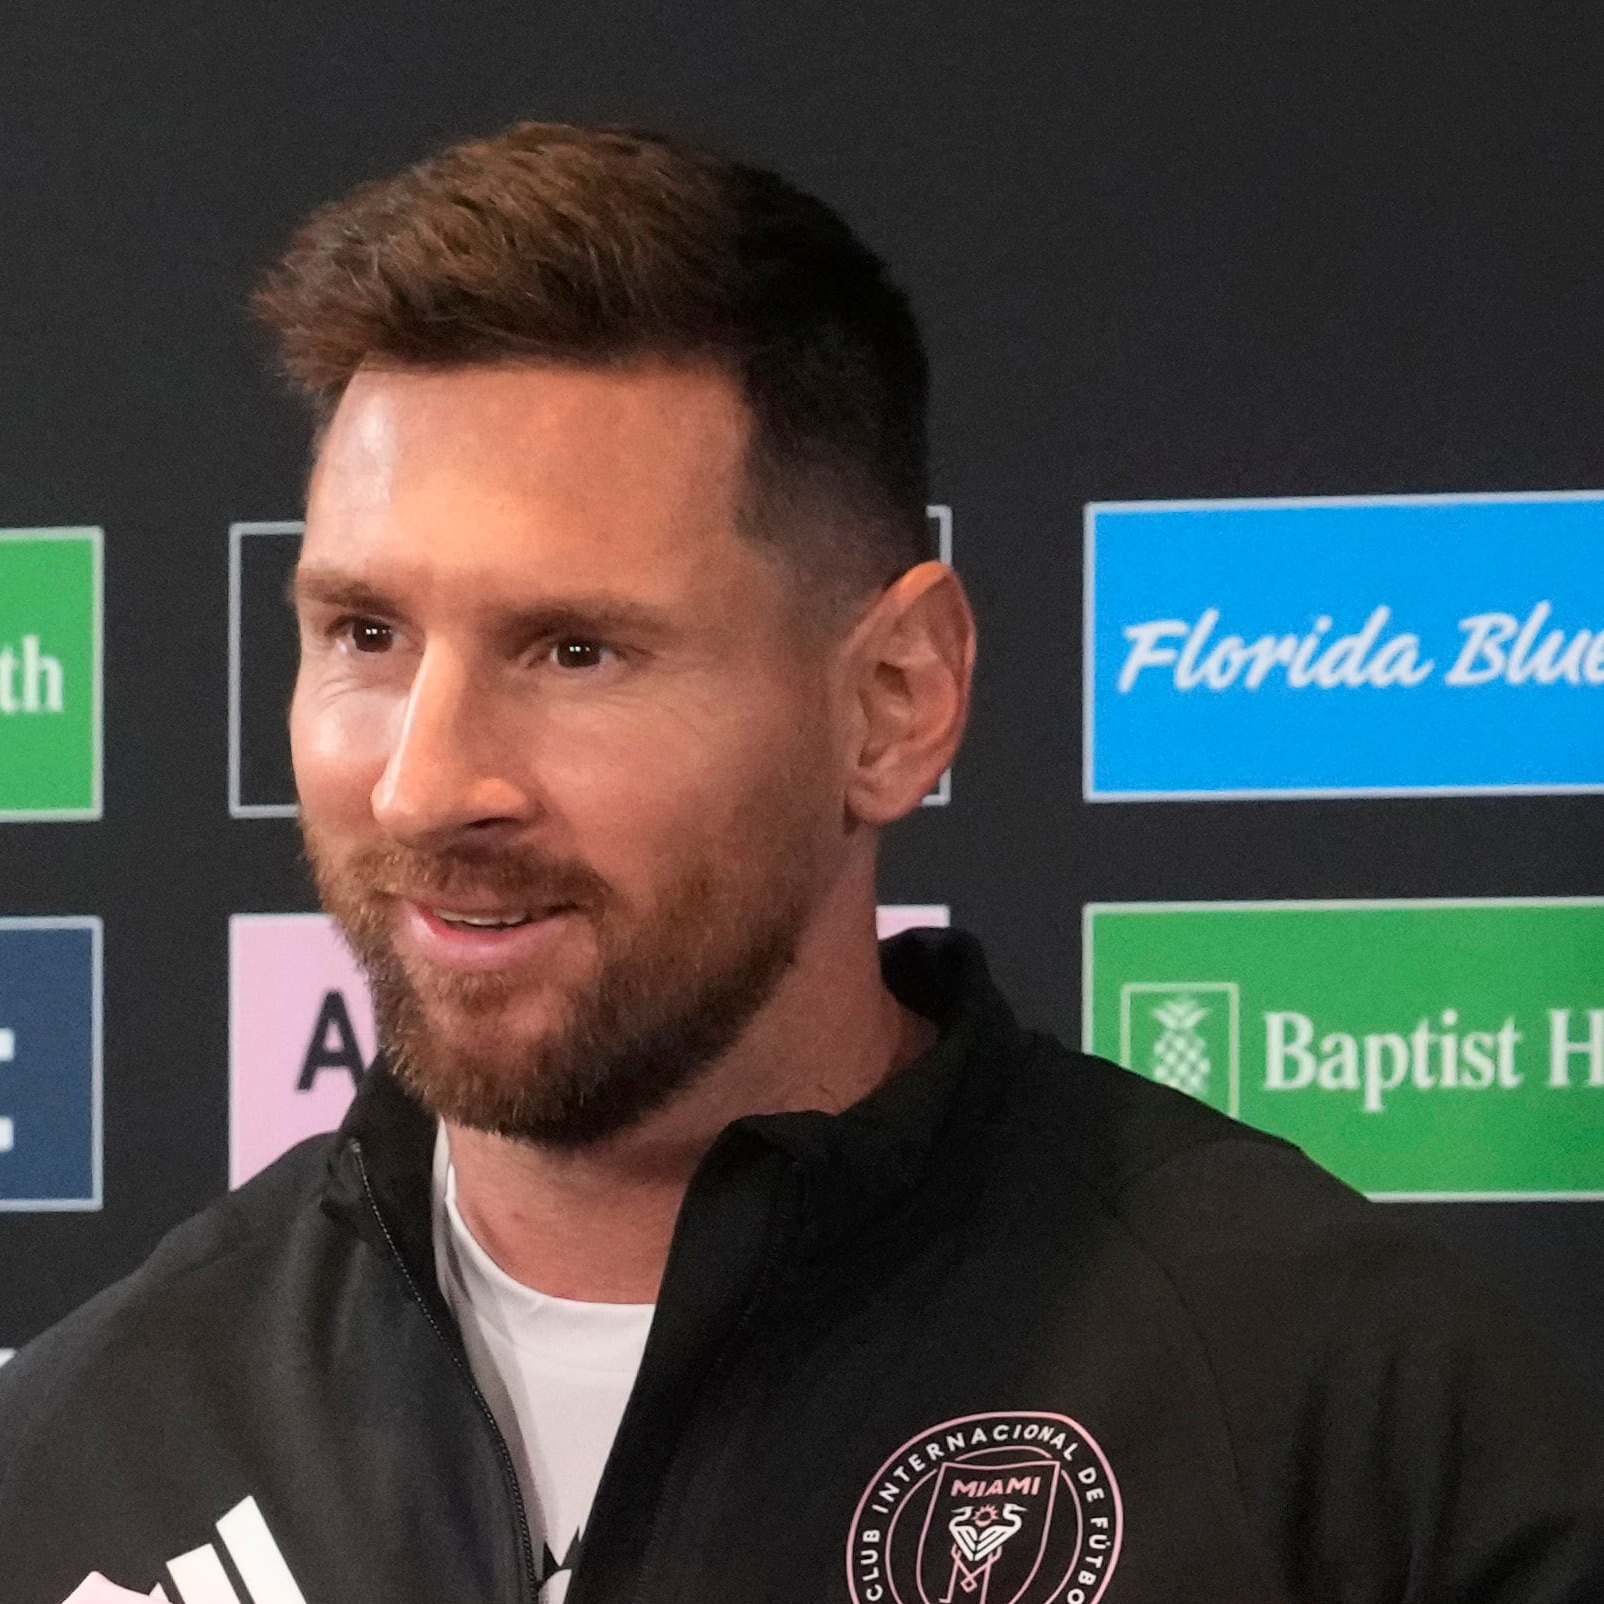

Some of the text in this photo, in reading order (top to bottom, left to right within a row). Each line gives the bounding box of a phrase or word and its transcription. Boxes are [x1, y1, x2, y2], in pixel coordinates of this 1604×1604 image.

[1117, 604, 1435, 694] Florida
[1262, 1007, 1523, 1114] Baptist
[871, 1424, 1079, 1514] INTERNACIONAL
[950, 1476, 1042, 1498] MIAMI
[1078, 1467, 1105, 1502] DE
[860, 1529, 884, 1602] CLUB
